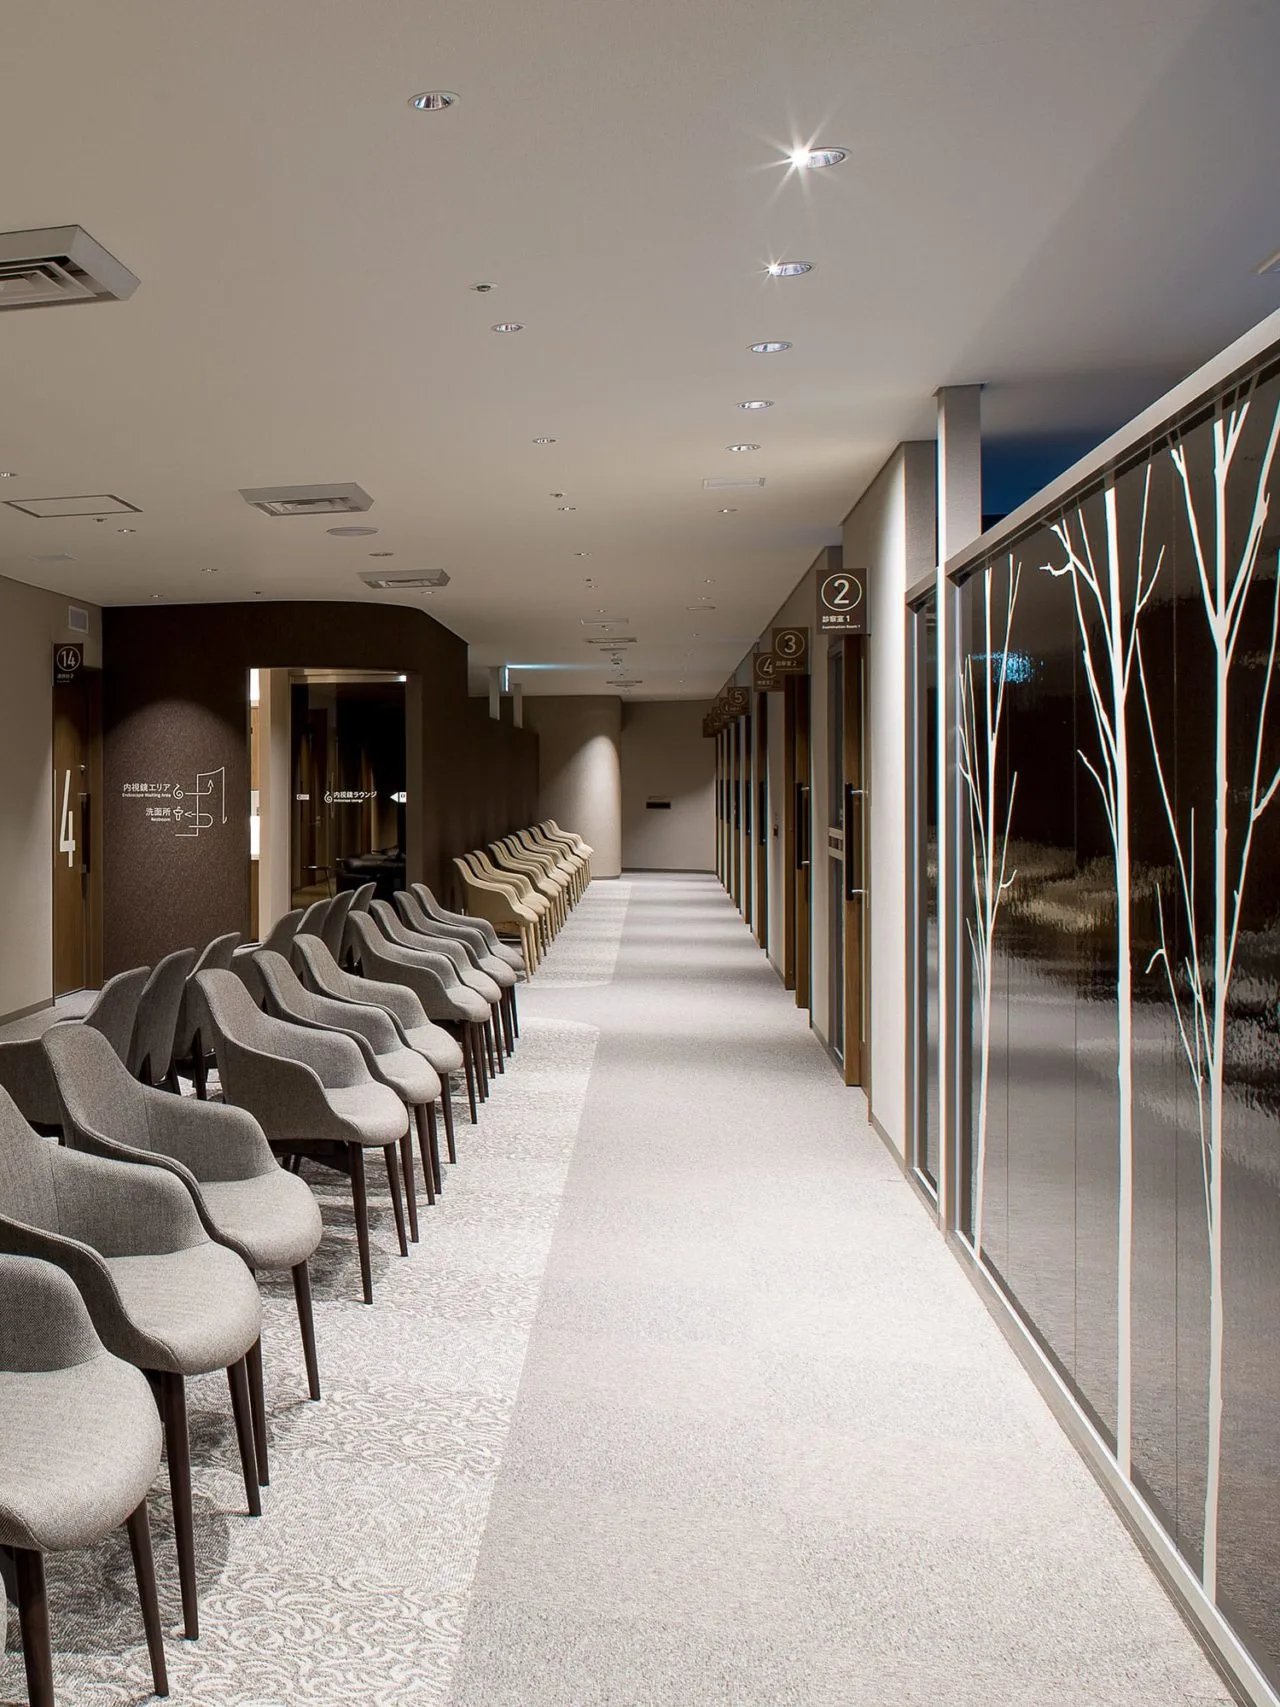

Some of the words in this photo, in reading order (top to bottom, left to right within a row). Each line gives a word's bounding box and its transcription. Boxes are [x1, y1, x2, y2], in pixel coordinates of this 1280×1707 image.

[833, 579, 850, 604] 2
[784, 634, 796, 653] 3
[61, 650, 76, 667] 14
[763, 658, 773, 674] 4
[734, 691, 743, 703] 5
[145, 807, 171, 817] 洗面所
